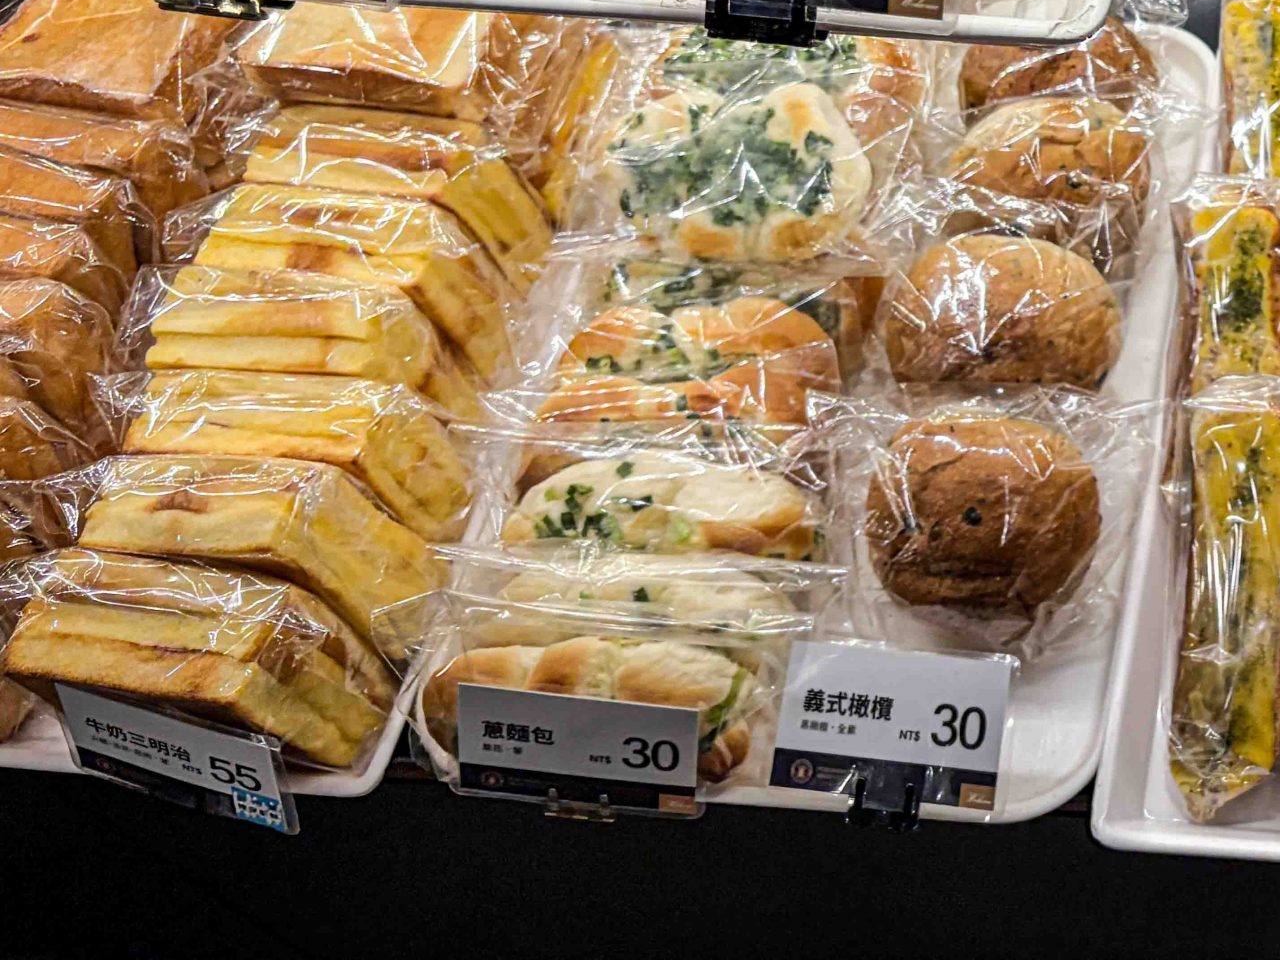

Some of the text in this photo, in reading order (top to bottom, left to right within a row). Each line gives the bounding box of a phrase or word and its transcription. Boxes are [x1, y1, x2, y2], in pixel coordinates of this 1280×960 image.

[803, 688, 894, 720] 義式橄欖
[85, 717, 191, 763] 牛奶三明治
[931, 704, 987, 750] 30
[622, 737, 680, 771] 30
[209, 756, 262, 791] 55
